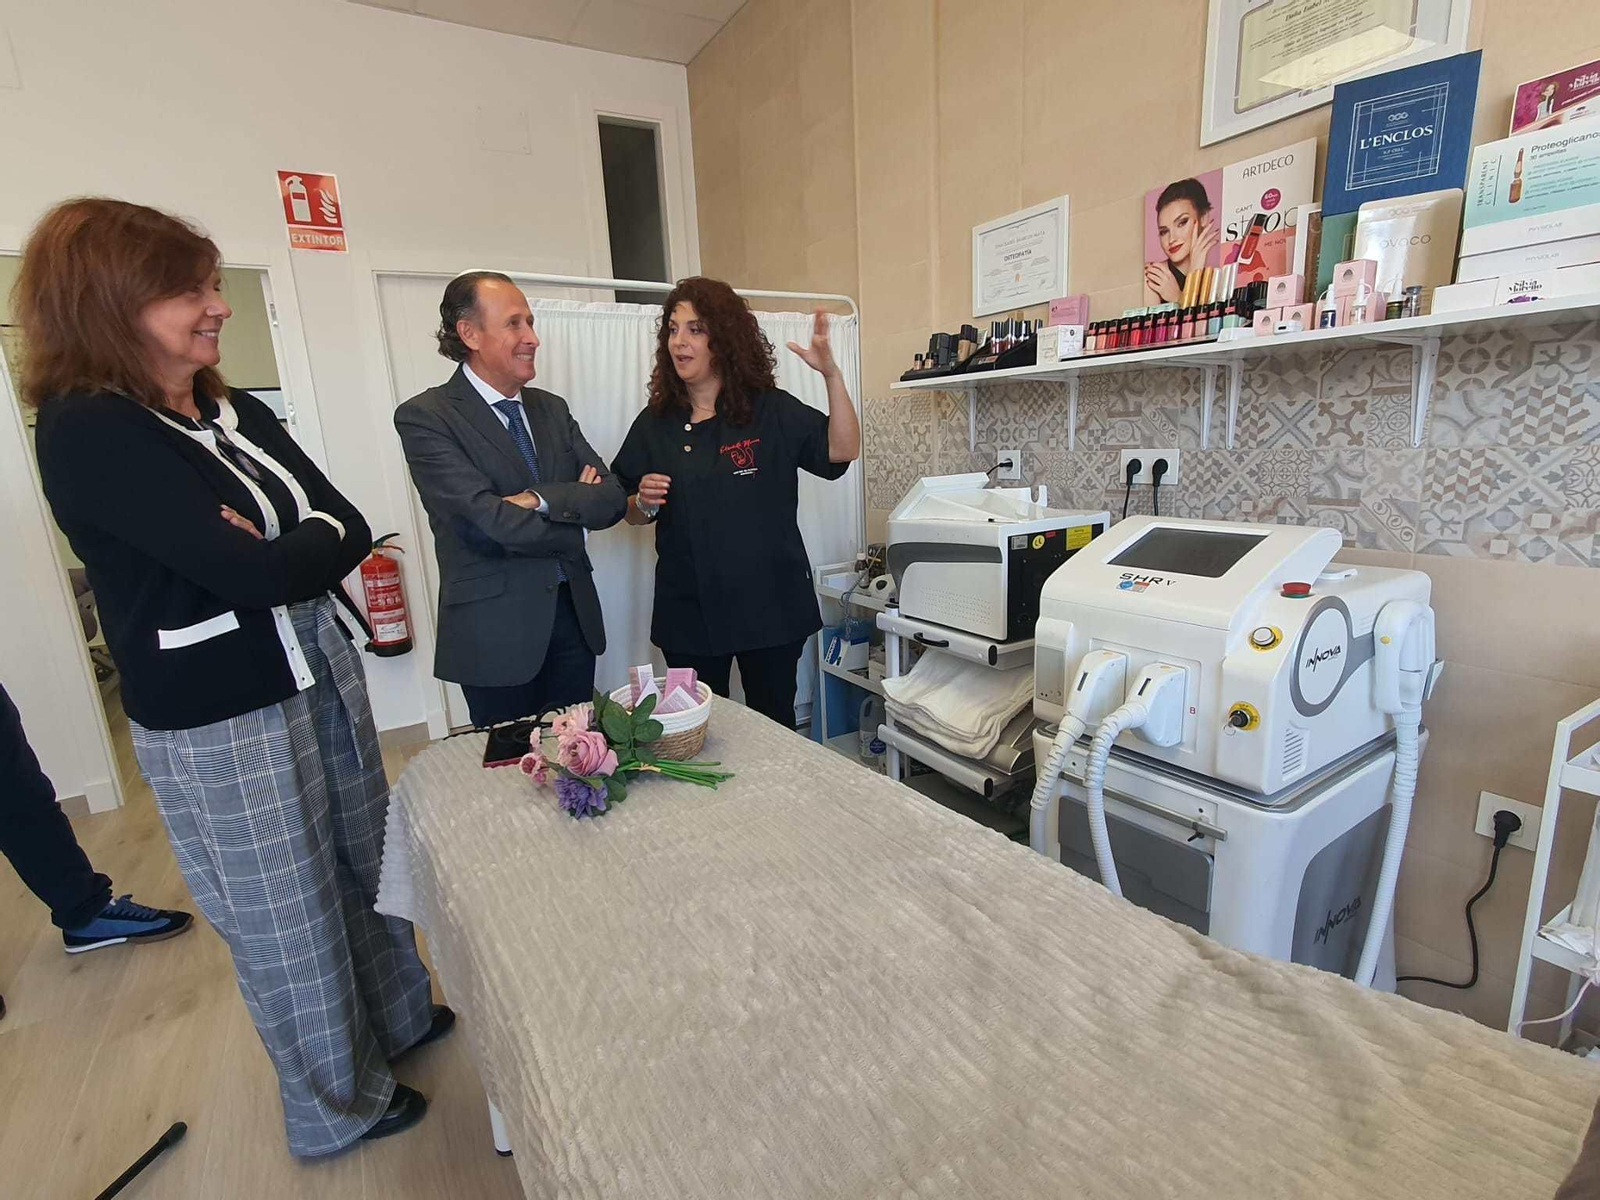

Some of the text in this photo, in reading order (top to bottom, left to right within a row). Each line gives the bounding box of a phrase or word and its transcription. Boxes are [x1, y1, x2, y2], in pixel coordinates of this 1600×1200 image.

[1360, 124, 1434, 150] L'ENCLOS
[1242, 154, 1295, 179] ARTDECO
[291, 233, 345, 246] EXTINTOR
[1119, 572, 1164, 585] SHR
[1305, 644, 1342, 673] INNOVA
[1312, 895, 1362, 945] INNOVA
